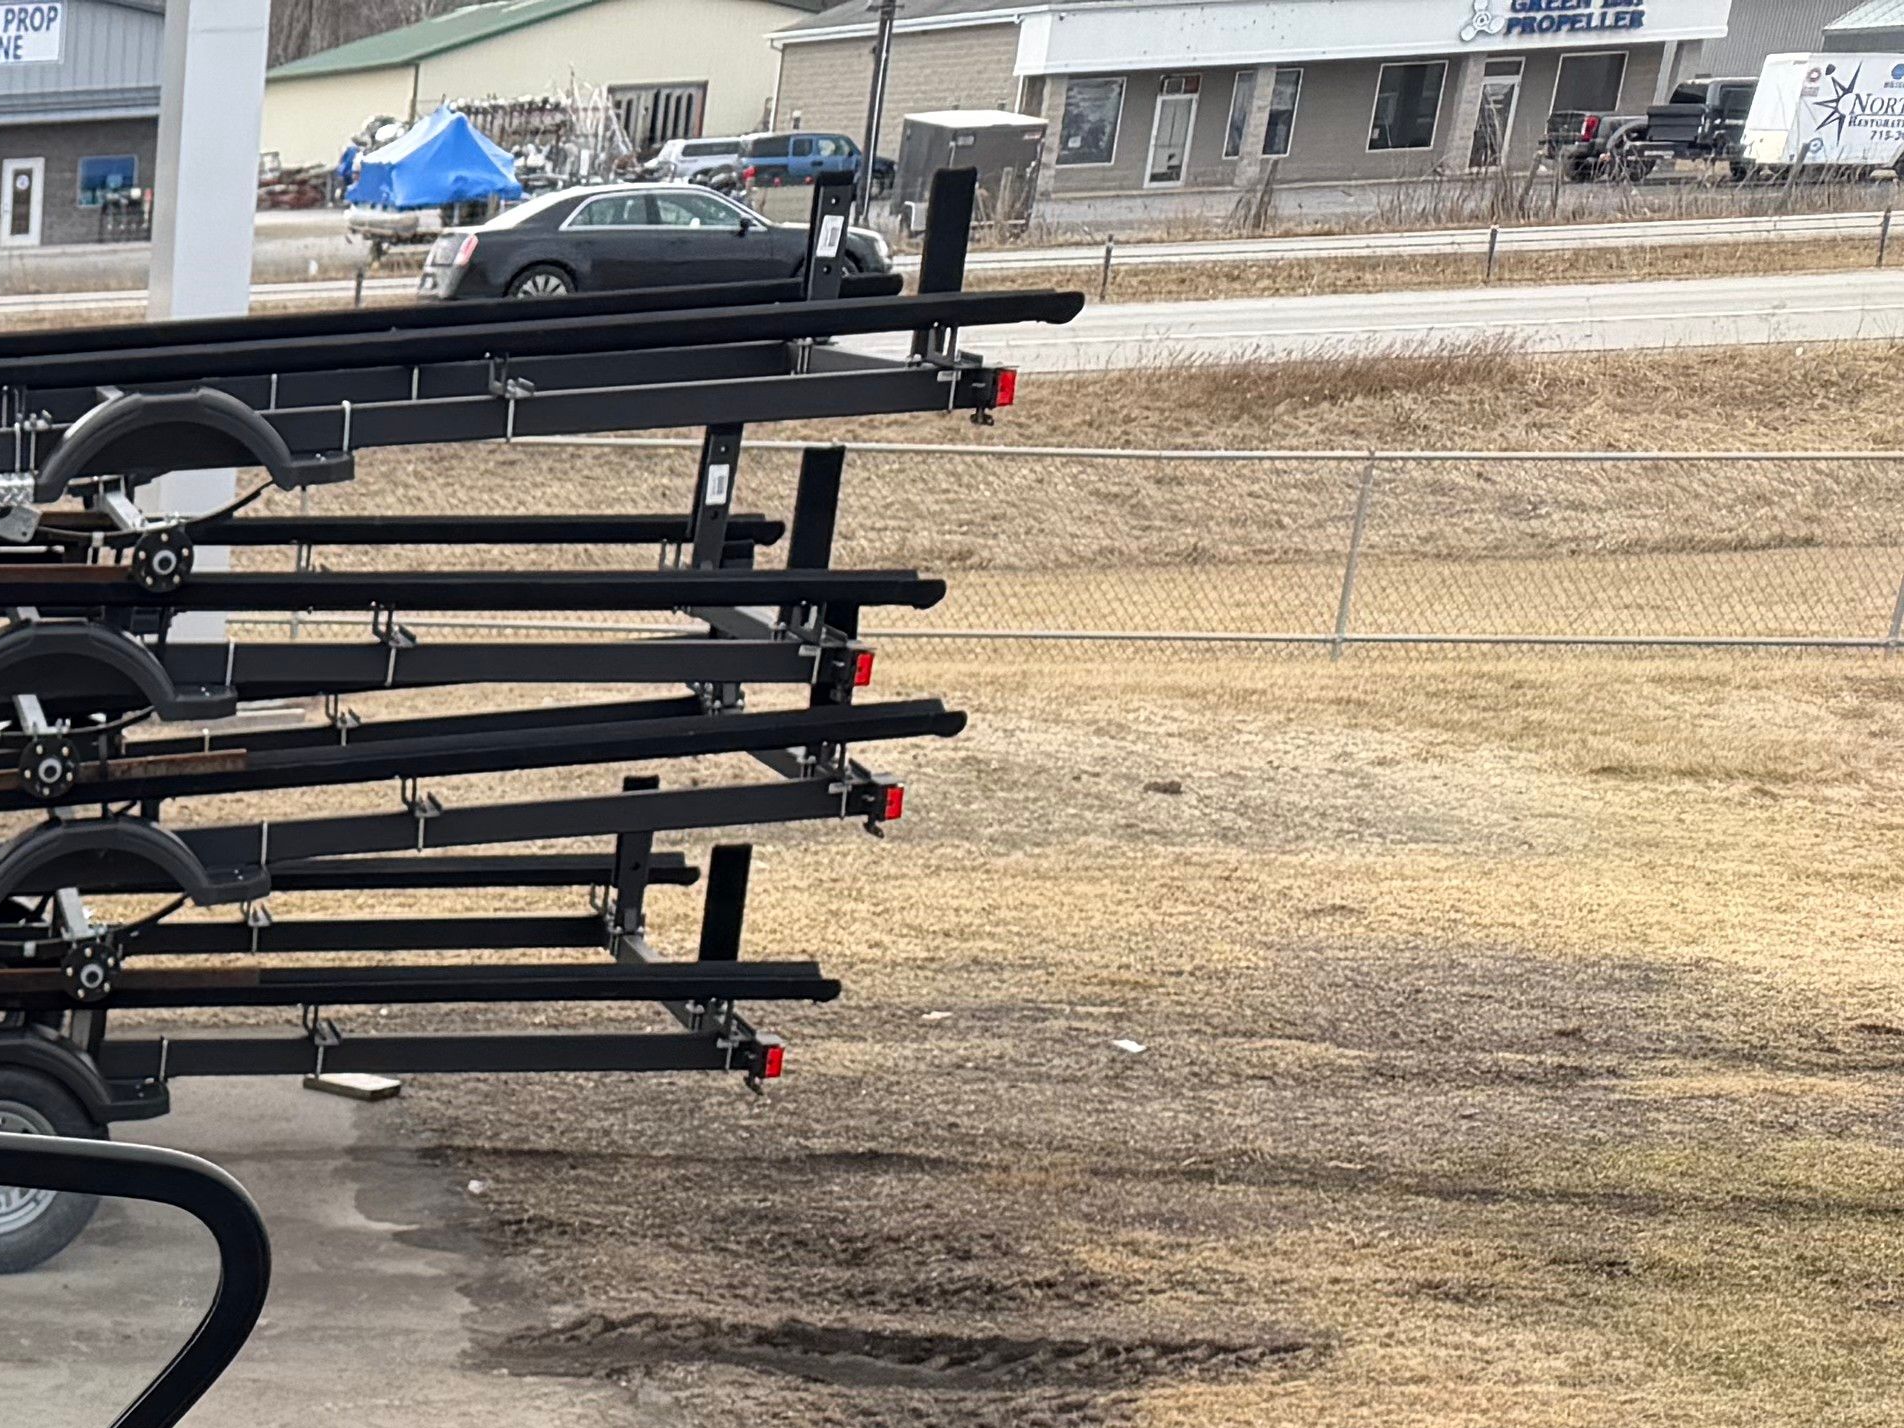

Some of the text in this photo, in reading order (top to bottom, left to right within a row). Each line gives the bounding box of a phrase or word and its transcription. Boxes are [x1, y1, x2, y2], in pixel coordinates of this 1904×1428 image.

[3, 5, 59, 32] PROP
[1504, 10, 1646, 36] PROPELLER
[1870, 129, 1904, 141] 715-3
